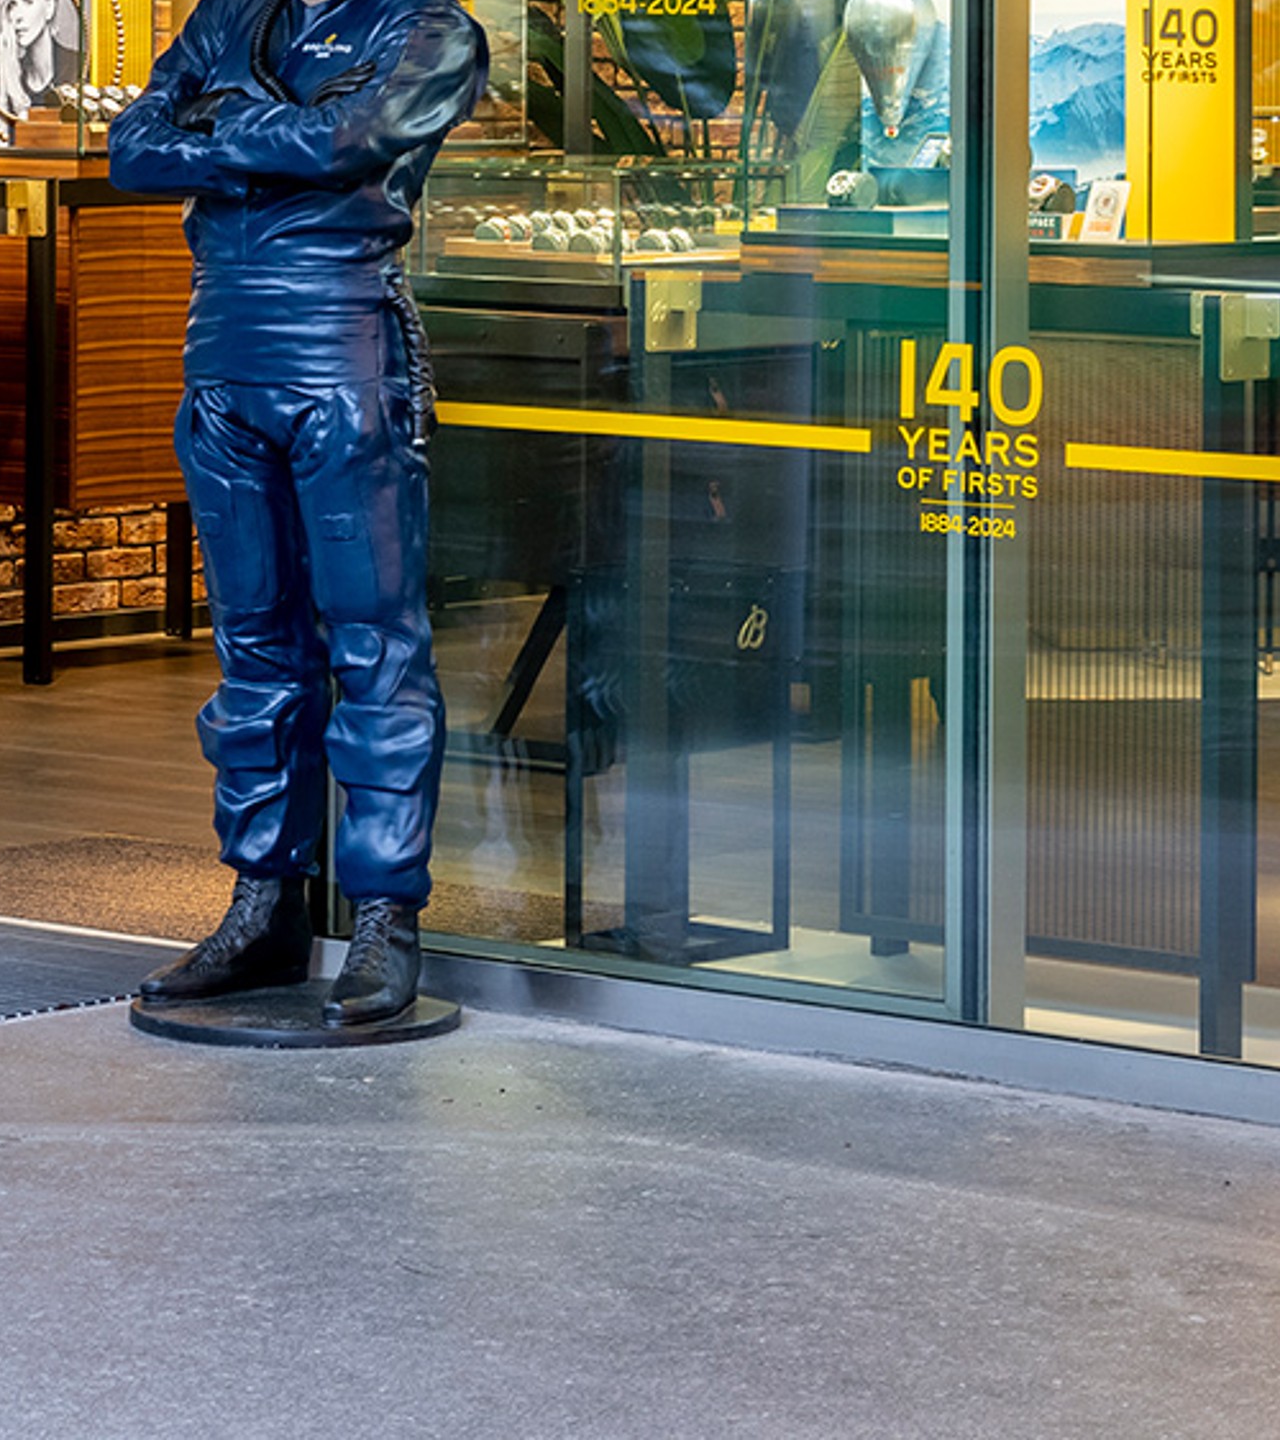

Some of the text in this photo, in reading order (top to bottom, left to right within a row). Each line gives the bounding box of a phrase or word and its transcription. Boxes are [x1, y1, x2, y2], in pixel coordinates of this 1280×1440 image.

[1142, 8, 1219, 48] 140
[1141, 52, 1218, 69] YEARS
[1168, 71, 1217, 84] FIRSTS
[899, 339, 1043, 427] 140
[898, 426, 1040, 468] YEARS
[897, 466, 1039, 499] OF FIRSTS
[920, 512, 1016, 539] 1884-2024
